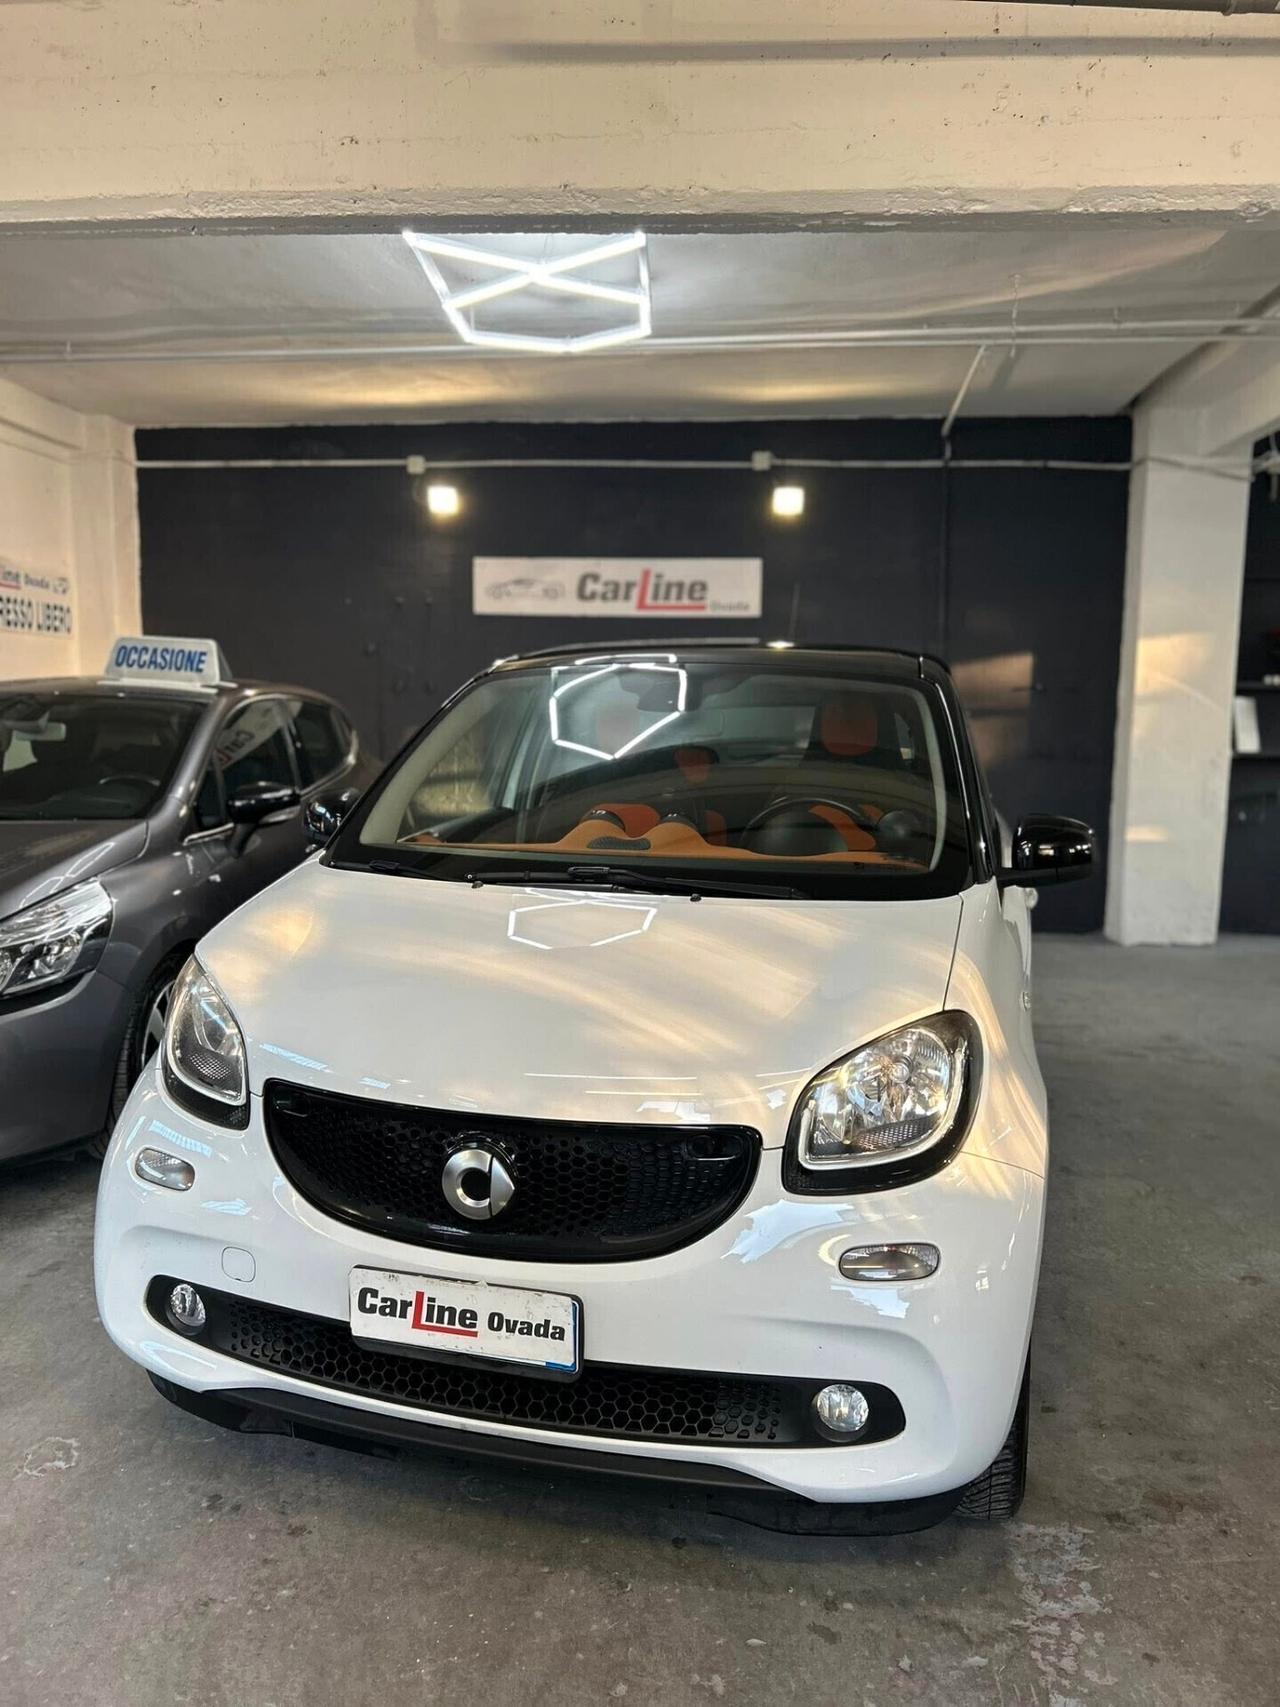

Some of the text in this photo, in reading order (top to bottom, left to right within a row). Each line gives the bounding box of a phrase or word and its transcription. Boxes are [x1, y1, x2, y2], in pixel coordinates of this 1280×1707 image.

[577, 568, 708, 611] CarLine
[36, 601, 72, 635] LIBERO
[114, 645, 209, 673] OCCASIONE
[357, 1286, 566, 1341] CarLine Ovada
